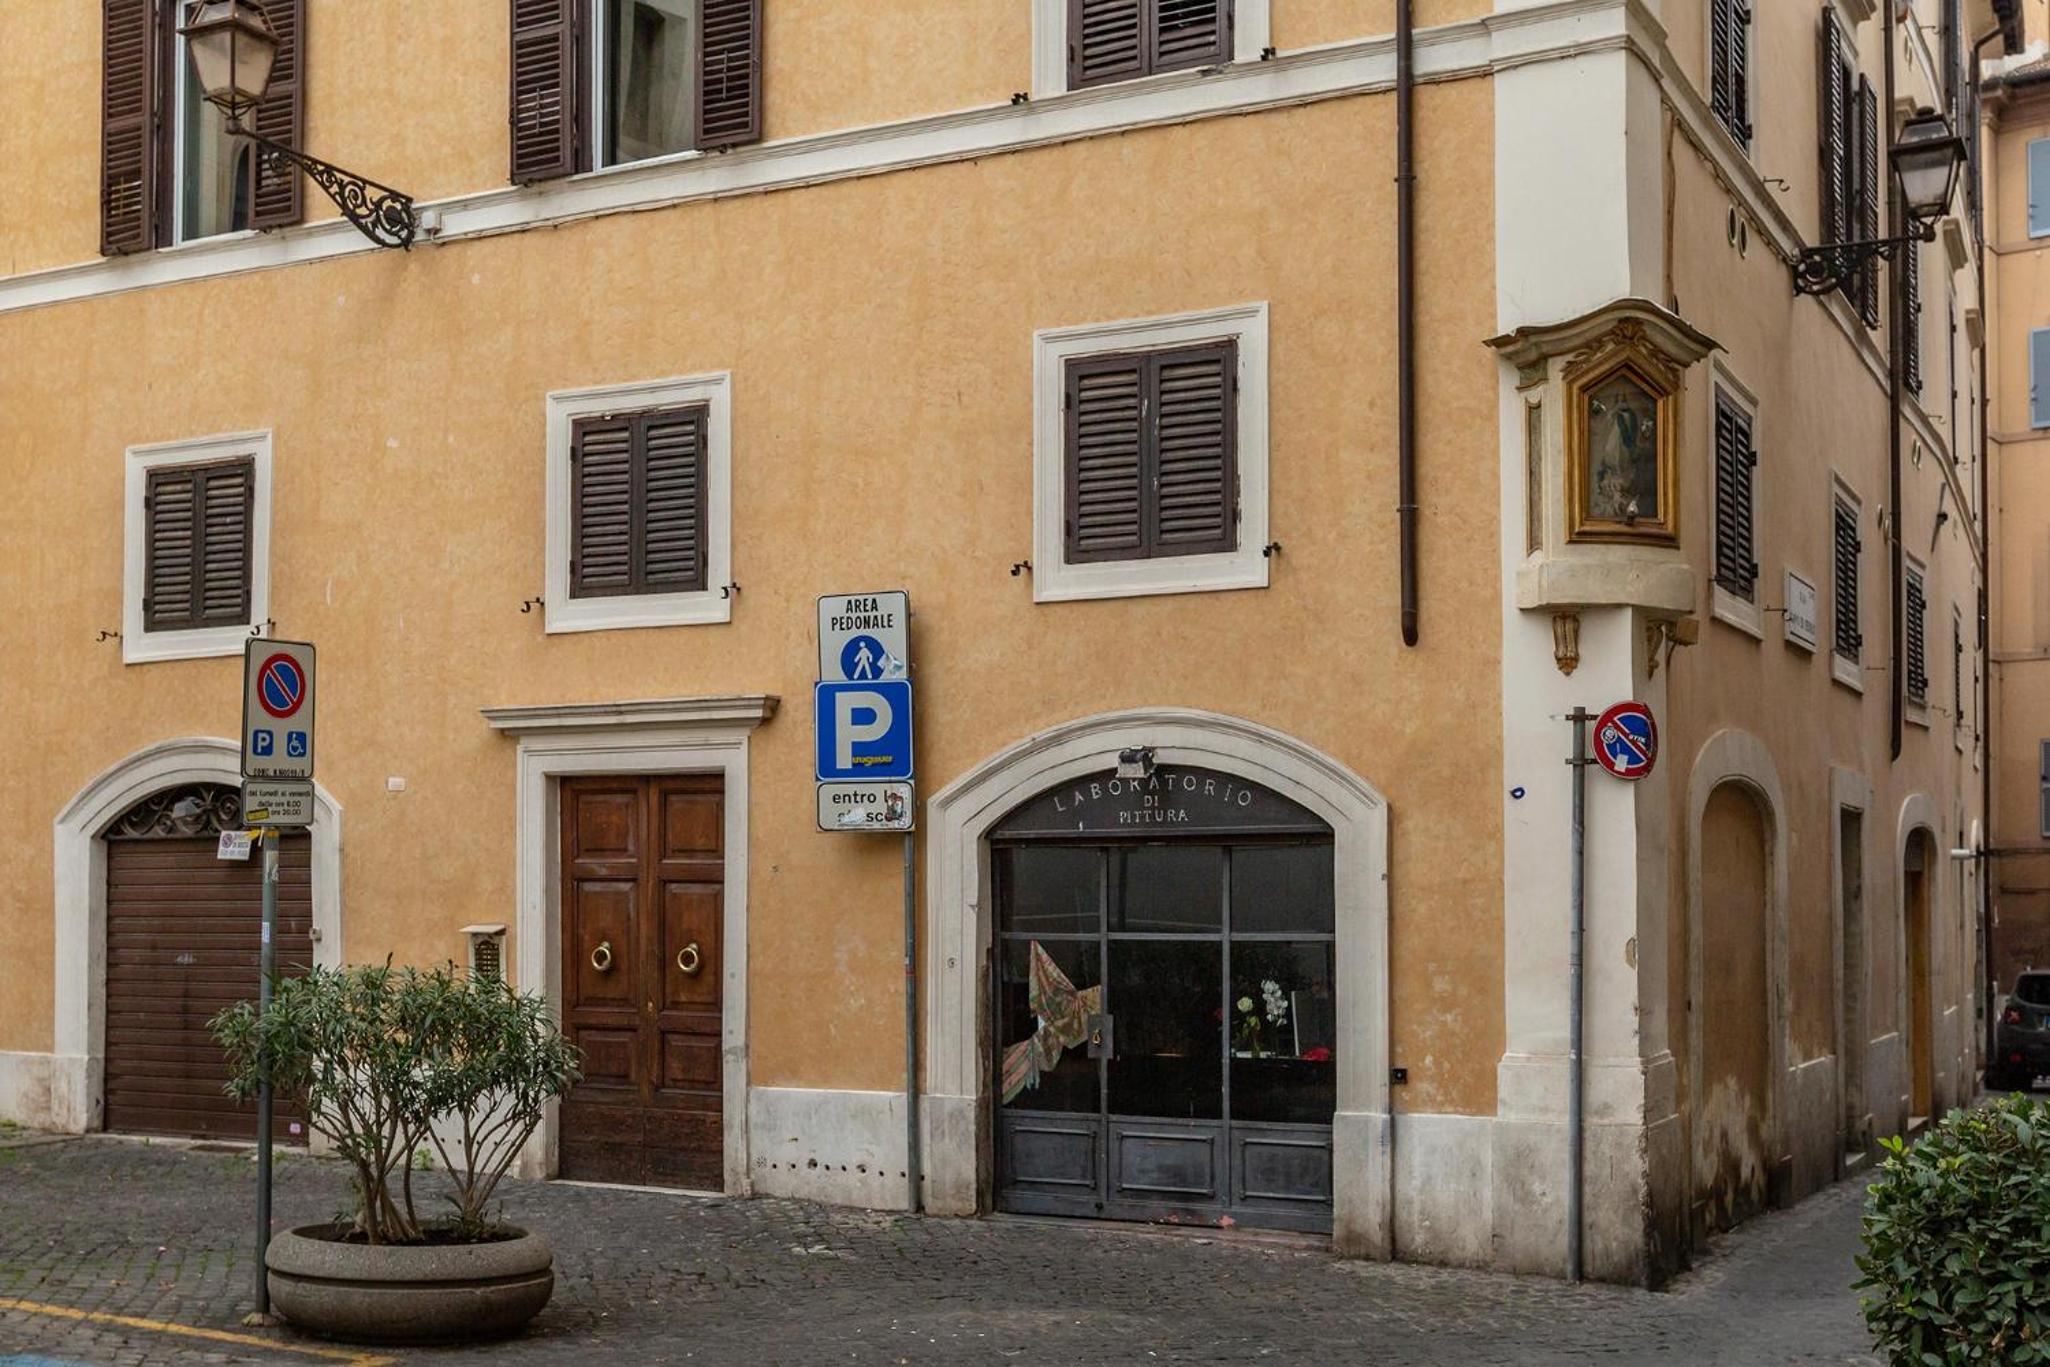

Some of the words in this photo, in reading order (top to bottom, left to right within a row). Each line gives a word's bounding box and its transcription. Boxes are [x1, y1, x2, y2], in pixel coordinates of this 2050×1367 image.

[846, 598, 878, 613] AREA
[831, 614, 893, 631] PEDONALE
[835, 691, 893, 769] P
[257, 732, 271, 753] P
[832, 790, 877, 804] entro
[1054, 775, 1251, 812] LABORATORIO
[1144, 795, 1158, 807] DI
[282, 808, 301, 816] 20.00
[1120, 809, 1188, 824] PITTURA
